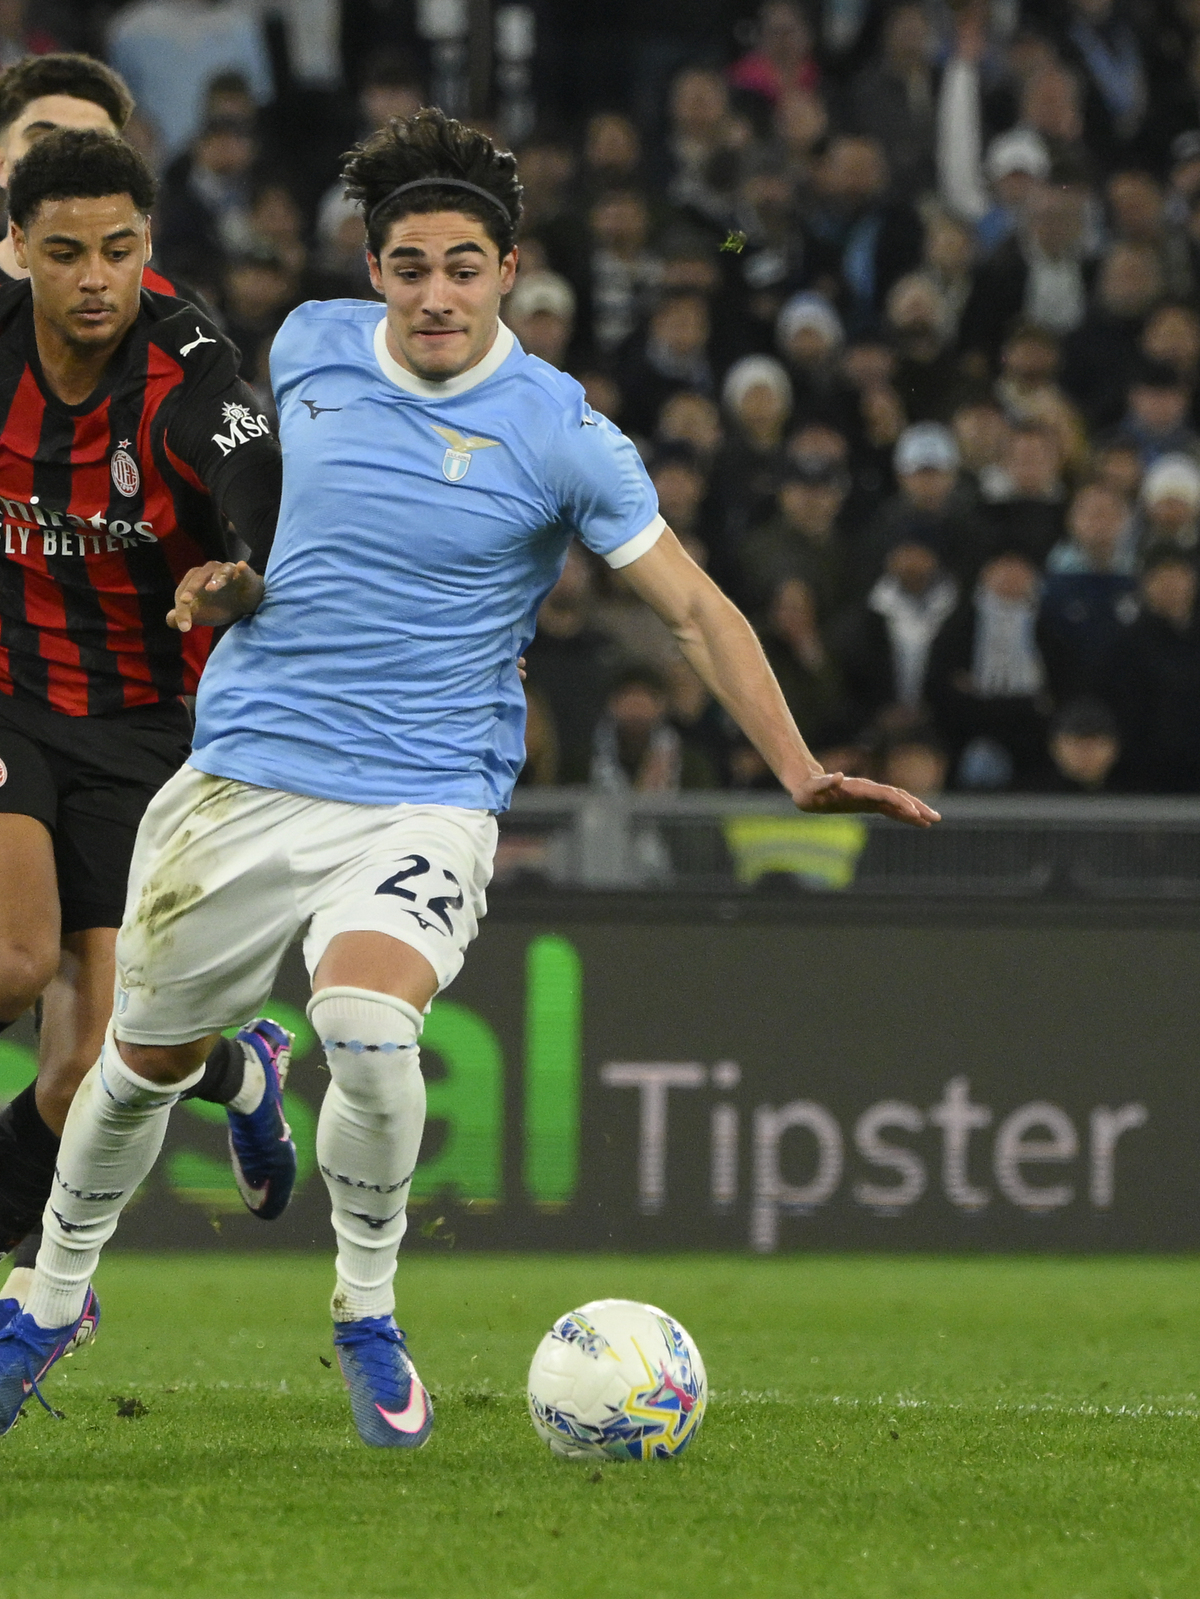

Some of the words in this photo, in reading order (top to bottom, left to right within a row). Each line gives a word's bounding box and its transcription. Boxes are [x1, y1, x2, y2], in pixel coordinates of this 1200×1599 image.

[43, 529, 138, 557] BETTER
[374, 854, 464, 937] 22
[600, 1061, 1149, 1252] Tipster
